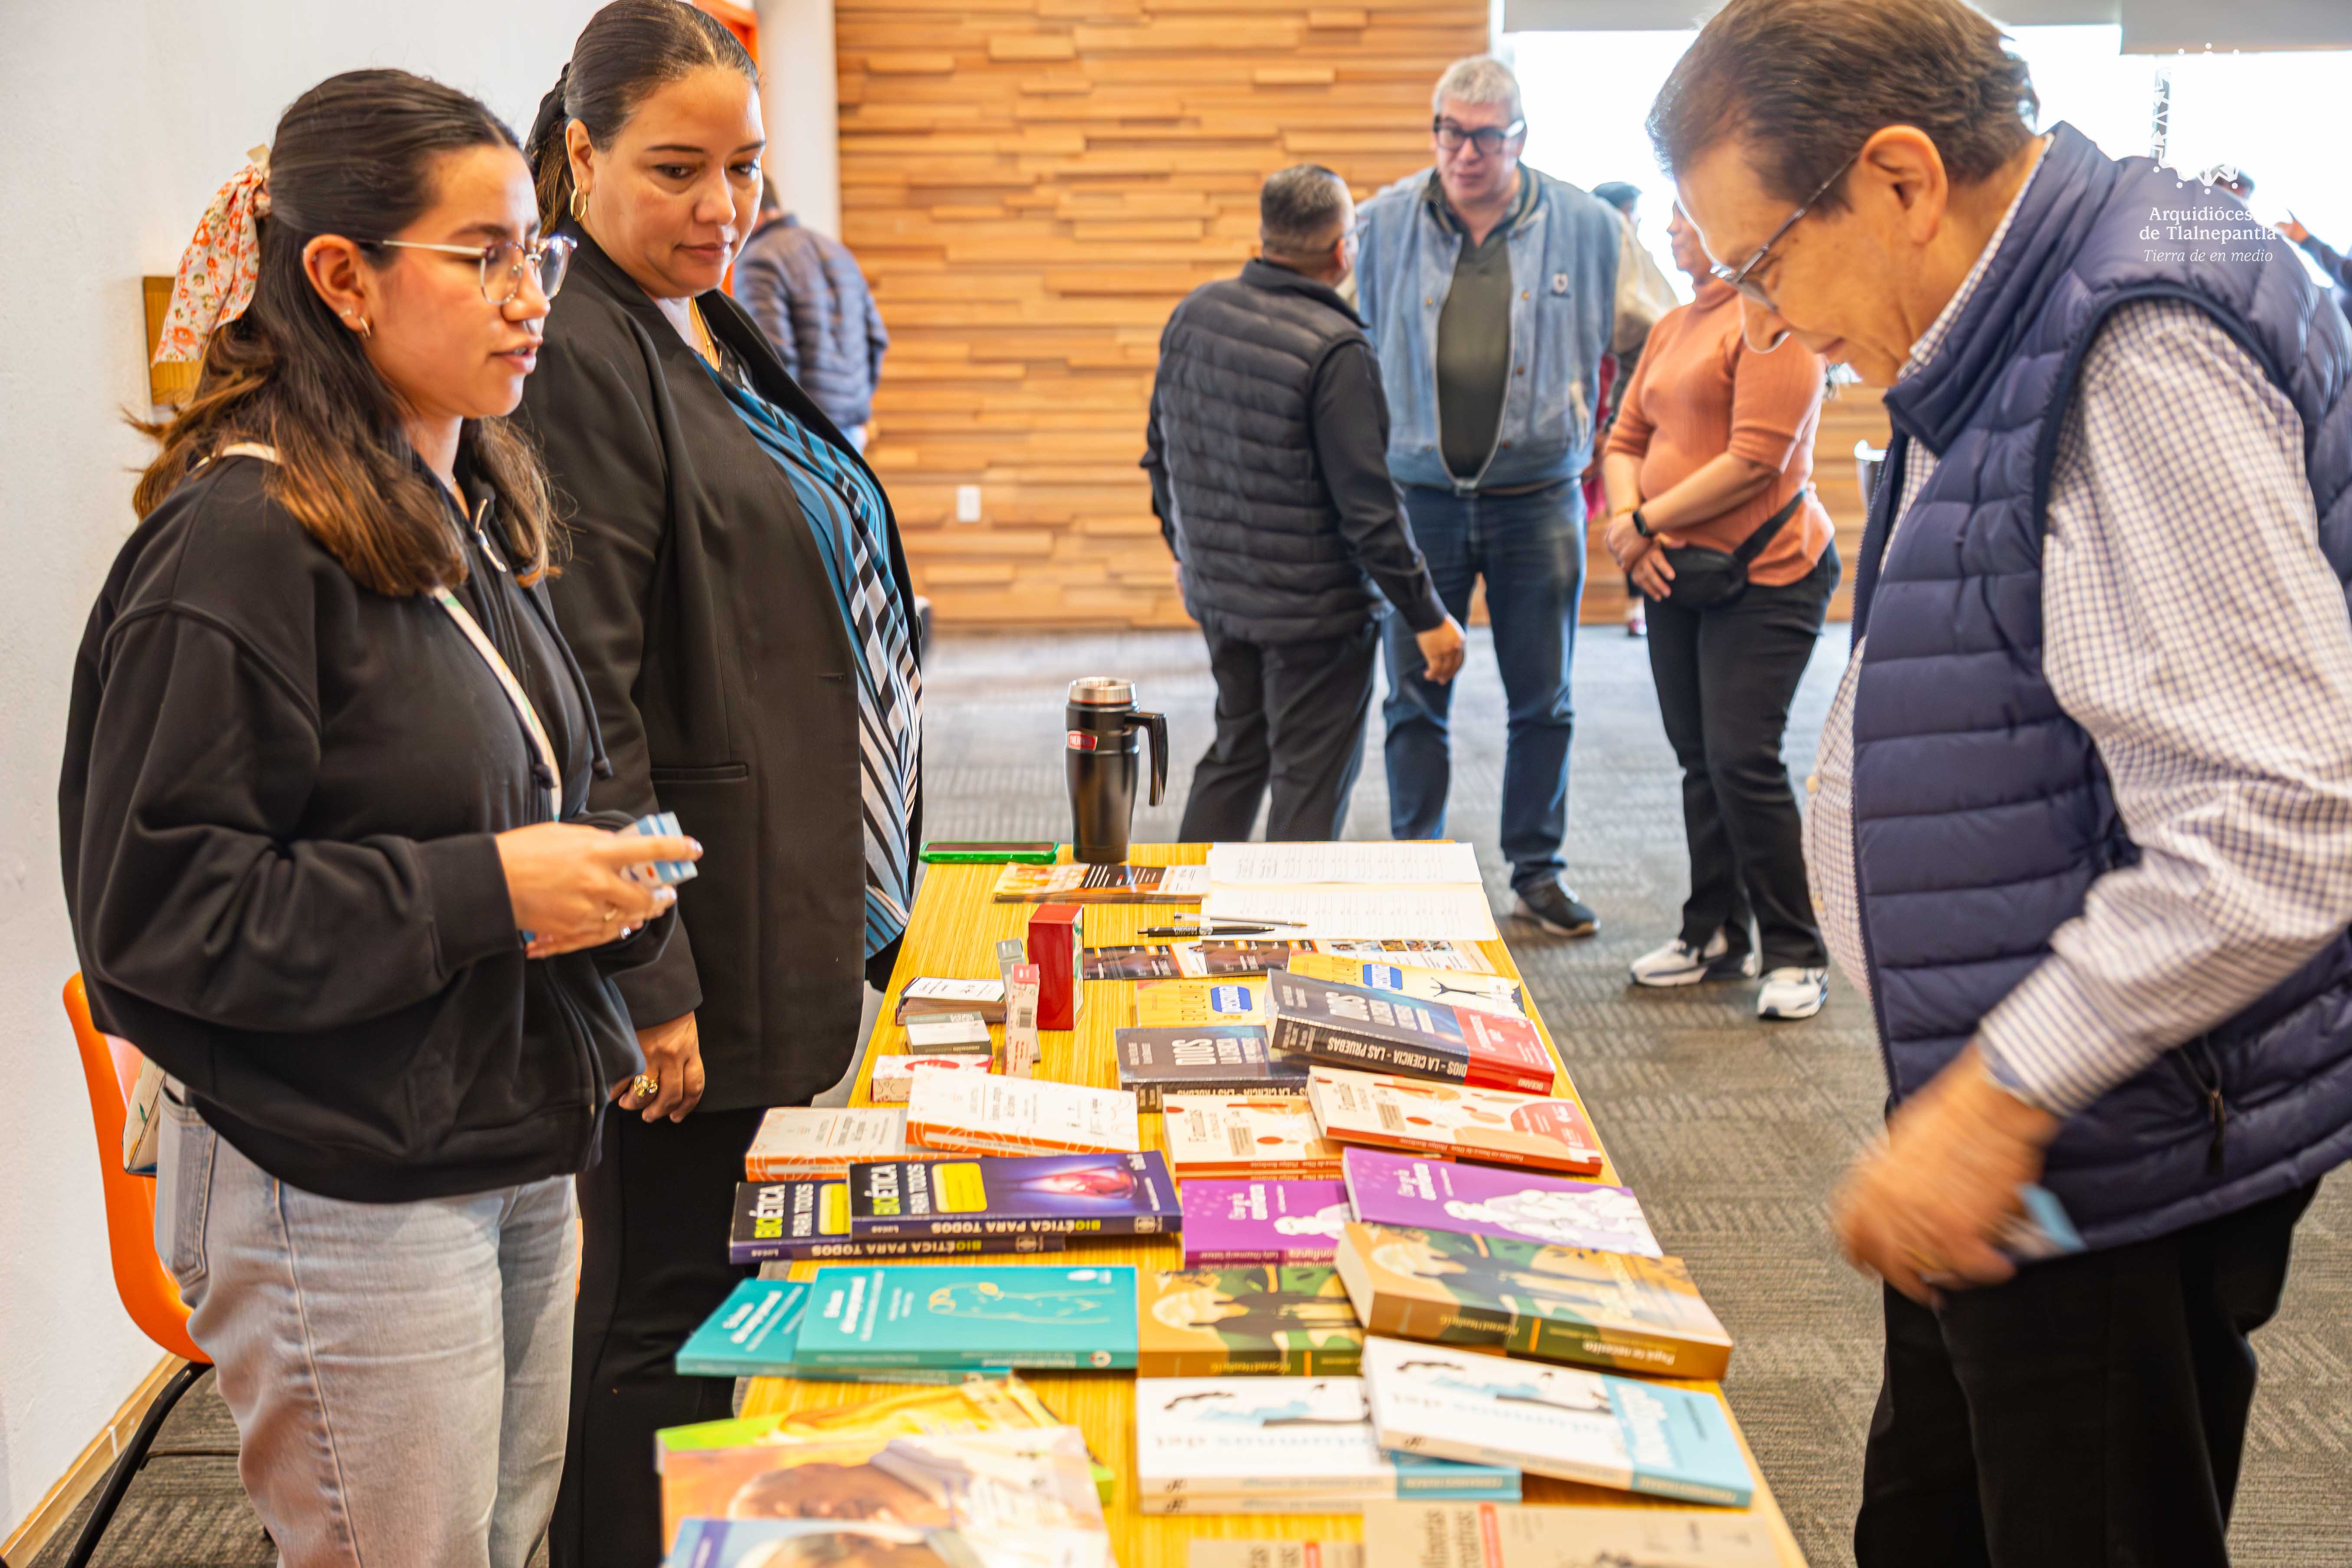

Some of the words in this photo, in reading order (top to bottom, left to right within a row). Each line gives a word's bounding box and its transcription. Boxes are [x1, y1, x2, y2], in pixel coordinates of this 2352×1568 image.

[1218, 986, 1249, 1014] persona
[1171, 1038, 1217, 1066] DIOS
[1327, 1036, 1367, 1058] PRUEBAS
[1367, 1045, 1386, 1062] LAS
[1393, 1050, 1426, 1069] CIENCIA
[1427, 1058, 1440, 1073] LA
[1448, 1061, 1468, 1077] DIOS
[1518, 1077, 1543, 1091] OCEANO
[906, 1163, 928, 1193] TODOS
[793, 1183, 814, 1213] TODOS
[864, 1164, 901, 1215] BIOÉTICA
[749, 1184, 785, 1238] BIOÉTICA
[909, 1192, 930, 1214] PARA
[792, 1213, 813, 1237] PARA
[931, 1222, 983, 1235] TODOS
[985, 1221, 1027, 1233] PARA
[1031, 1219, 1102, 1235] BIOÉTICA
[810, 1243, 863, 1257] TODOS
[869, 1241, 907, 1254] PARA
[910, 1239, 982, 1256] BIOÉTICA
